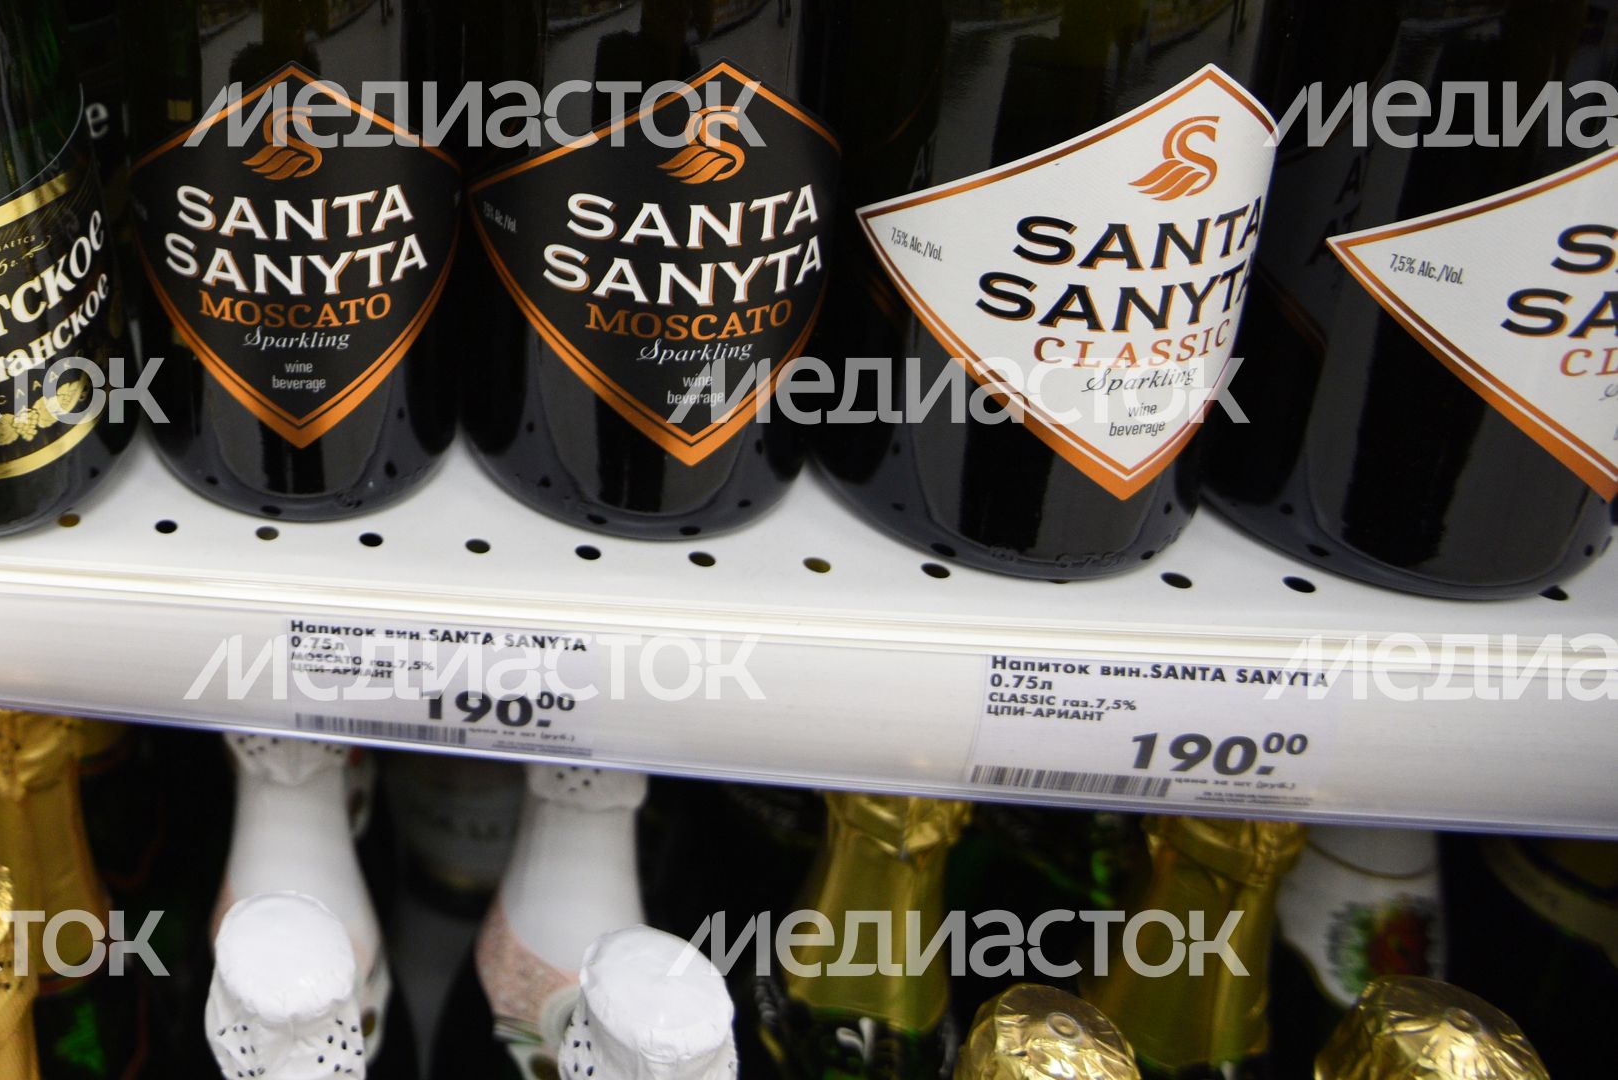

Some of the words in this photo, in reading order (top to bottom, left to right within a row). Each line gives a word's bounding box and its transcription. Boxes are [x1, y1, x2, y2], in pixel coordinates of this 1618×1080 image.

[176, 183, 416, 241] SANTA
[566, 183, 820, 249] SANTA
[1012, 195, 1261, 271] SANTA
[164, 233, 429, 296] SANYTA
[542, 235, 823, 307] SANYTA
[1390, 253, 1416, 274] 7,5%
[1417, 260, 1463, 284] Alc./Vol.
[199, 290, 392, 329] MOSCATO
[584, 298, 793, 340] MOSCATO
[243, 325, 350, 351] Sparkling
[636, 338, 753, 365] Sparkling
[1033, 318, 1231, 369] CLASSIC
[284, 359, 313, 373] wine
[272, 374, 326, 393] beverage
[683, 373, 713, 388] wine
[1081, 367, 1198, 396] Sparkling
[667, 390, 724, 407] beverage
[1127, 402, 1157, 418] wine
[1109, 421, 1166, 438] beverage
[290, 620, 375, 637] Напиток
[504, 632, 587, 652] SANYTA
[291, 635, 345, 651] 0.75л
[291, 651, 363, 666] MOSCATO
[991, 655, 1090, 675] Напиток
[1236, 668, 1329, 687] SANYTA
[989, 673, 1053, 690] 0.75л
[986, 704, 1104, 721] ЦПИ-АРИАНТ
[988, 692, 1056, 706] CLASSIC
